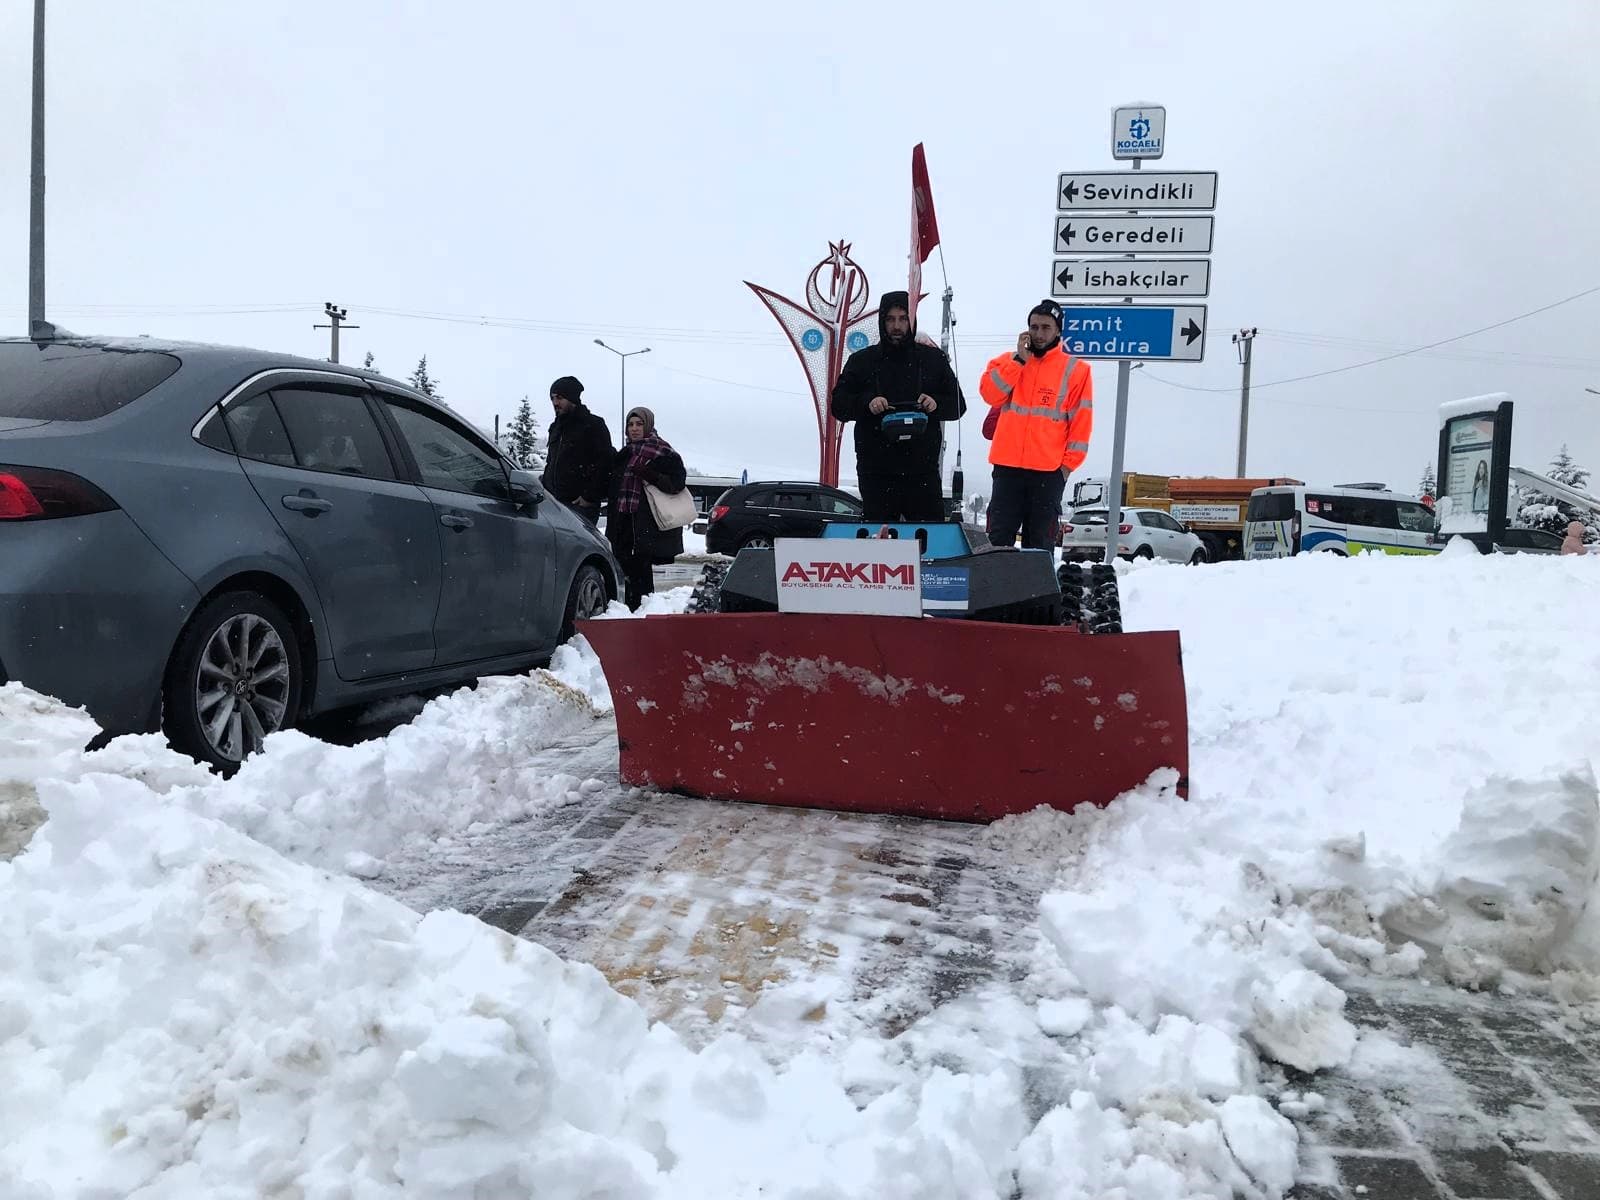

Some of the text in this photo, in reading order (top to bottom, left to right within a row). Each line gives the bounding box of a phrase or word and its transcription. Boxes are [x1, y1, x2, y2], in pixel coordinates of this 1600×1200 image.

[1117, 138, 1161, 148] KOCAELİ
[1083, 183, 1193, 200] Sevindikli
[1085, 226, 1184, 243] Geredeli
[1084, 267, 1189, 289] İshakçılar
[1060, 335, 1150, 353] Kandıra
[782, 561, 915, 585] A-TAKIMI
